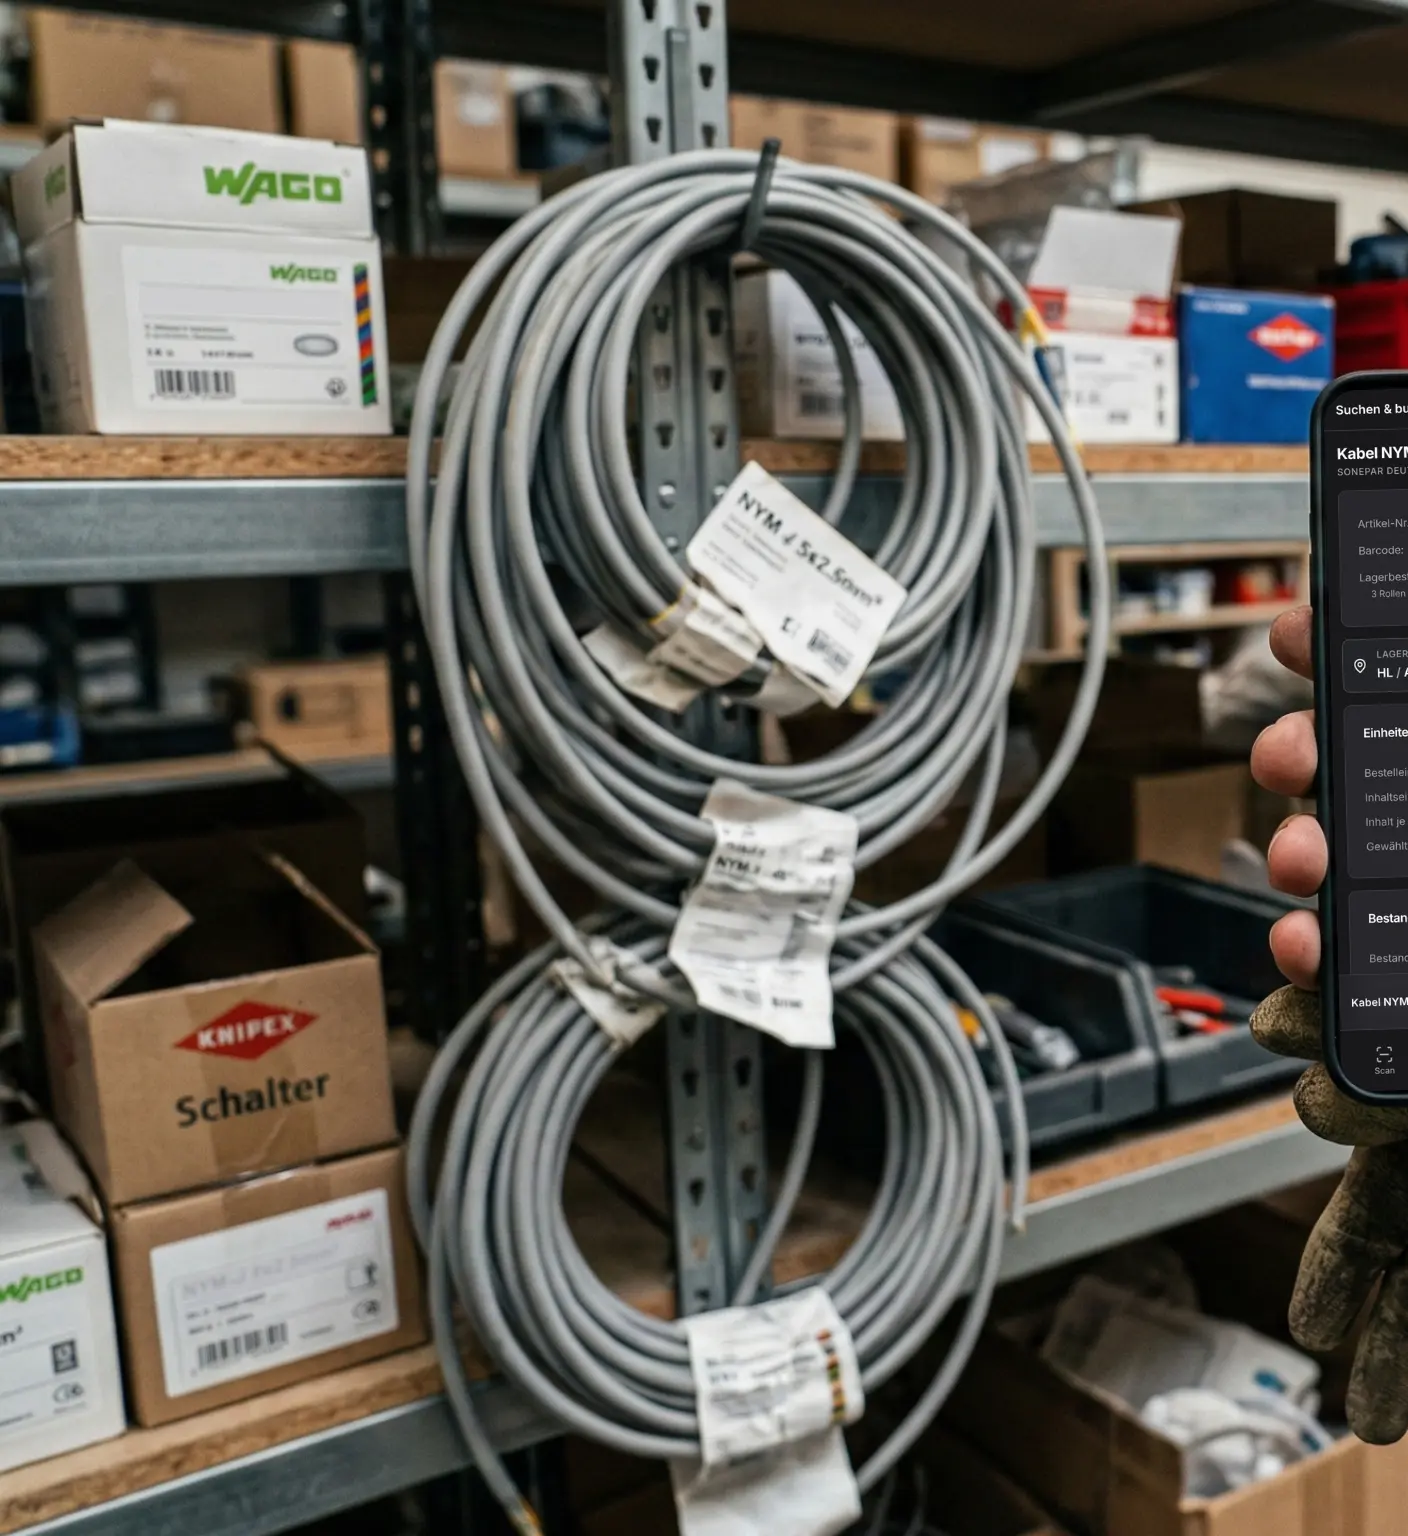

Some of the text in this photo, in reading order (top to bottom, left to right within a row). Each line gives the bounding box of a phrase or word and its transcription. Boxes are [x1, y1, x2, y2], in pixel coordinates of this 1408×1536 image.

[203, 161, 343, 206] WAGO
[269, 264, 339, 284] WAGO
[1336, 405, 1380, 415] Suchen
[1384, 404, 1391, 414] &
[1337, 447, 1378, 459] Kabel
[1338, 467, 1383, 476] SONEPAR
[1359, 546, 1403, 555] Barcode:
[1372, 590, 1376, 598] 3
[1378, 668, 1393, 677] HL
[1396, 667, 1401, 678] /
[1366, 818, 1393, 827] Inhalt
[1396, 817, 1405, 828] je
[1352, 998, 1380, 1007] Kabel
[197, 1012, 297, 1050] KNIPEX
[175, 1072, 330, 1129] Schalter
[0, 1266, 84, 1303] WAGO
